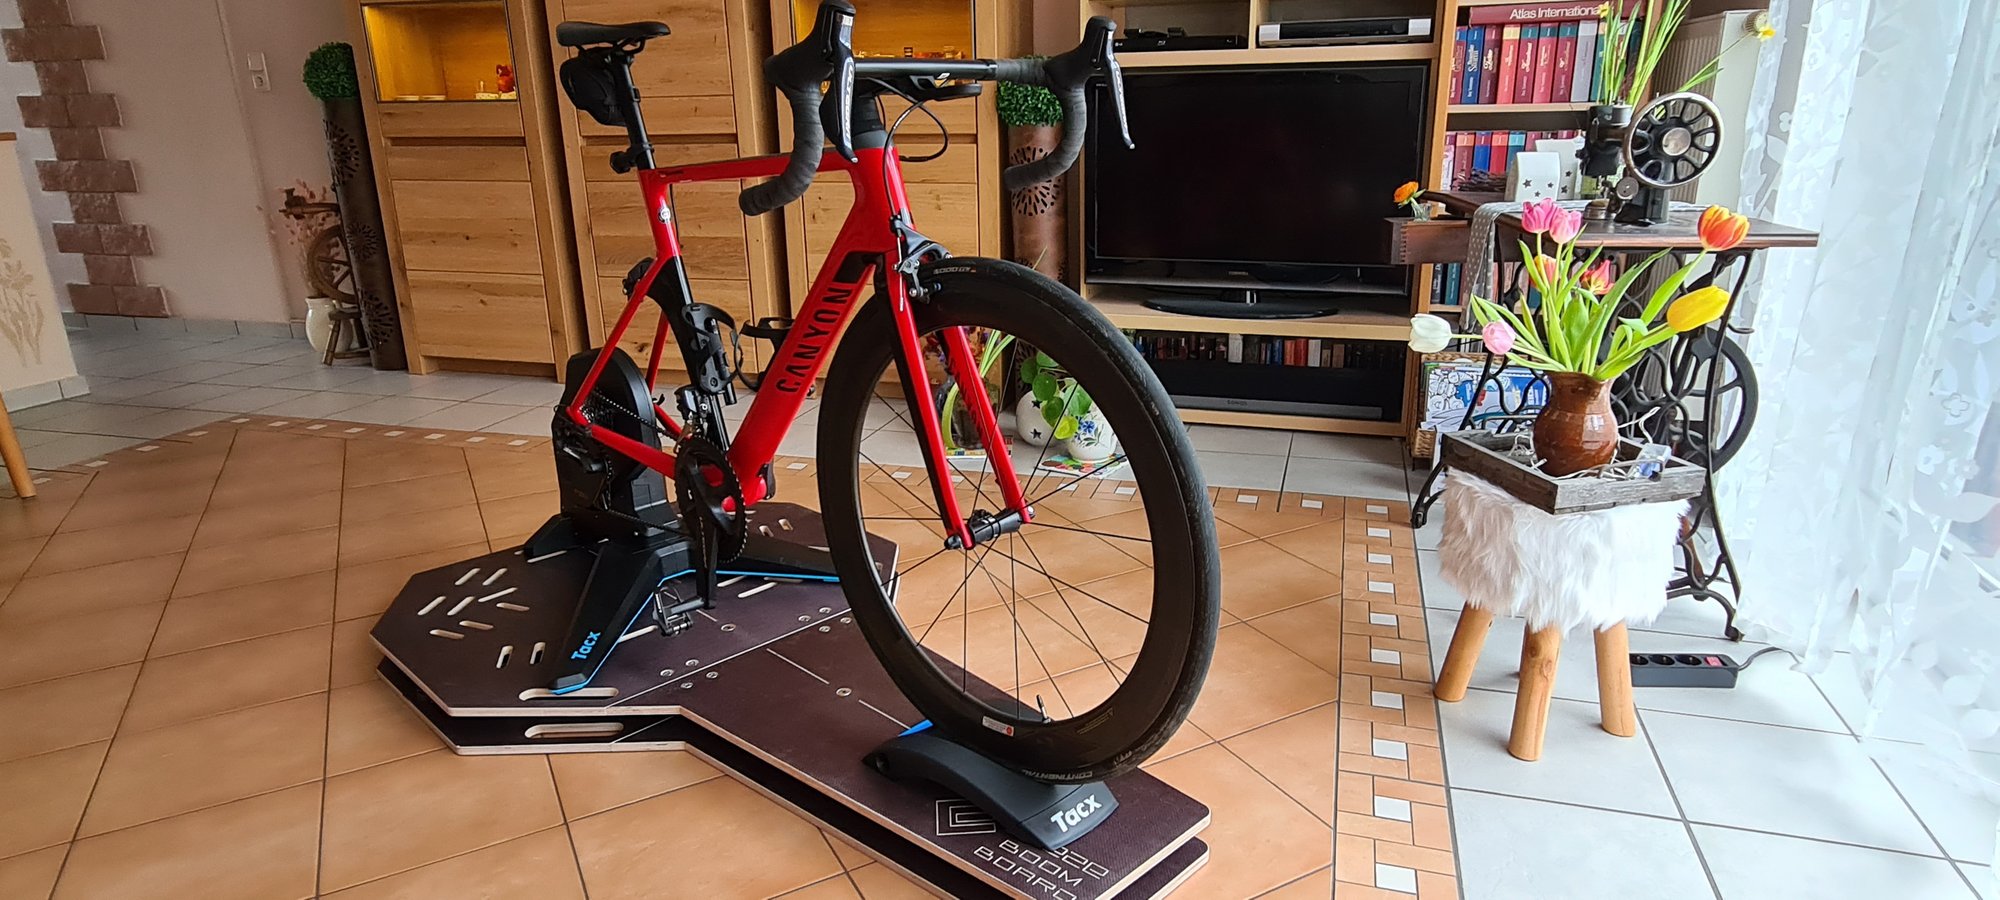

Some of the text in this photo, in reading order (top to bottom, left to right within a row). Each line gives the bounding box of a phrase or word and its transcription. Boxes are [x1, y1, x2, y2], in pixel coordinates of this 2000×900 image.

[1510, 5, 1600, 19] Atlas Internationa
[776, 287, 853, 392] CANYON
[571, 631, 602, 660] Tacx
[1022, 769, 1092, 780] CONTINENTAL
[1050, 794, 1102, 833] Tacx
[998, 839, 1083, 887] BOOM
